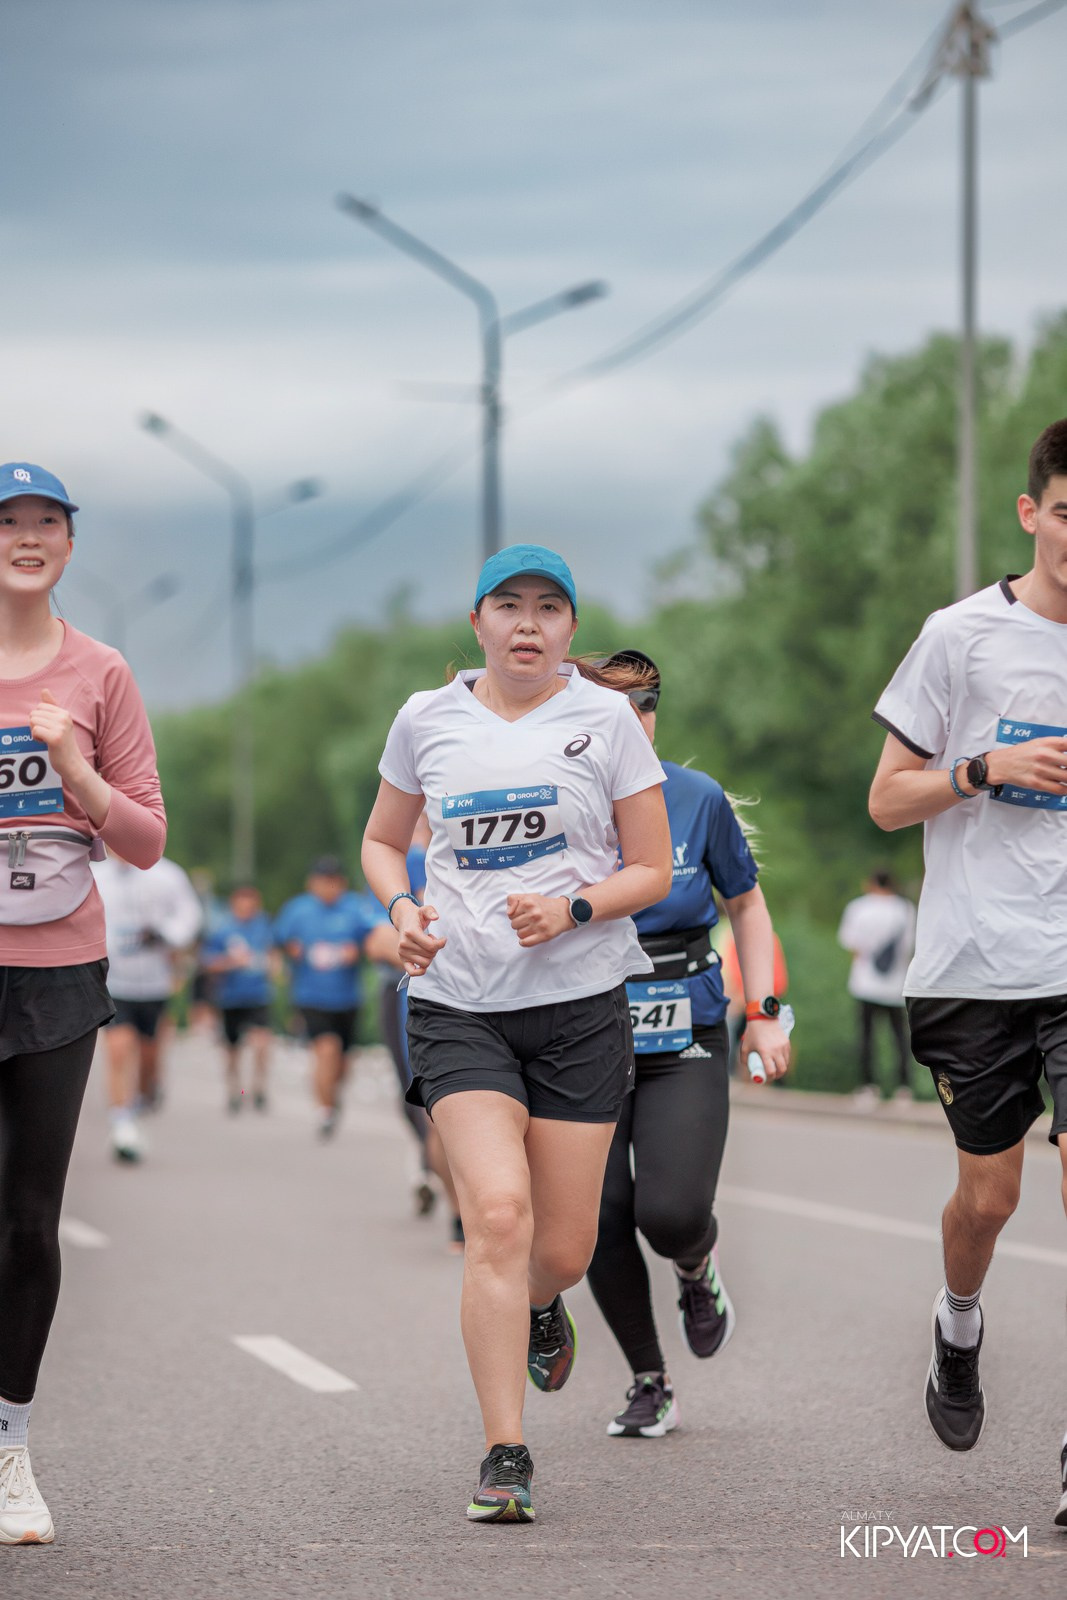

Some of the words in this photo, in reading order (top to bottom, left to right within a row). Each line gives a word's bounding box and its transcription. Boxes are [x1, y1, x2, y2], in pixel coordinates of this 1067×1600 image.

[1002, 724, 1013, 734] 5
[1014, 729, 1031, 738] KM
[517, 792, 540, 800] GROUP
[447, 799, 456, 809] 5
[457, 799, 474, 808] KM
[461, 810, 547, 846] 1779
